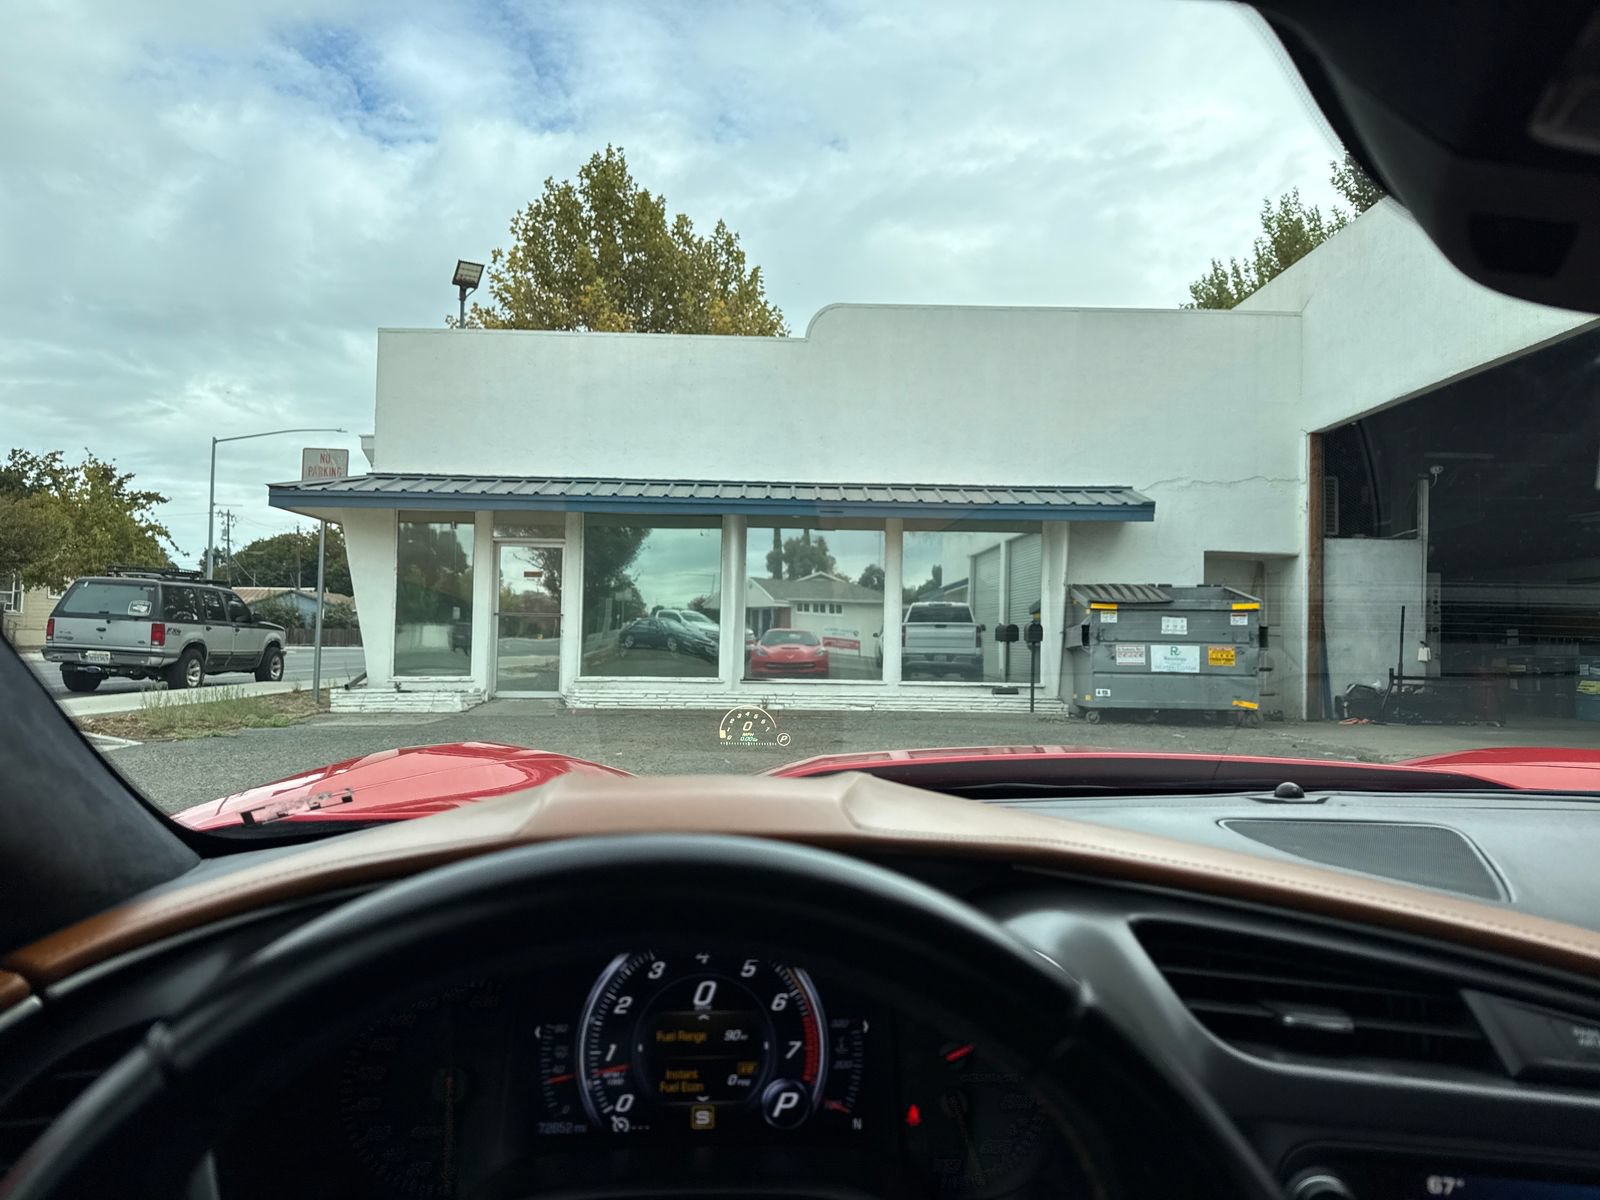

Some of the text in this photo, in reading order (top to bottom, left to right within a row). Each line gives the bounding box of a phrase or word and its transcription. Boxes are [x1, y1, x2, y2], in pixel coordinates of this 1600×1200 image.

[320, 453, 331, 464] NO
[308, 466, 342, 477] PARKING
[743, 721, 753, 731] 0
[780, 735, 787, 743] P
[648, 961, 666, 980] 3
[740, 959, 759, 978] 5
[693, 980, 718, 1006] 0
[613, 996, 633, 1015] 2
[770, 993, 789, 1011] 6
[656, 1030, 708, 1044] Fuel Range
[724, 1029, 742, 1041] 90
[605, 1043, 617, 1062] 1
[785, 1041, 803, 1060] 7
[659, 1081, 679, 1093] Fuel
[615, 1093, 635, 1112] 0
[772, 1092, 800, 1118] P
[695, 1110, 710, 1125] S
[852, 1118, 863, 1130] N
